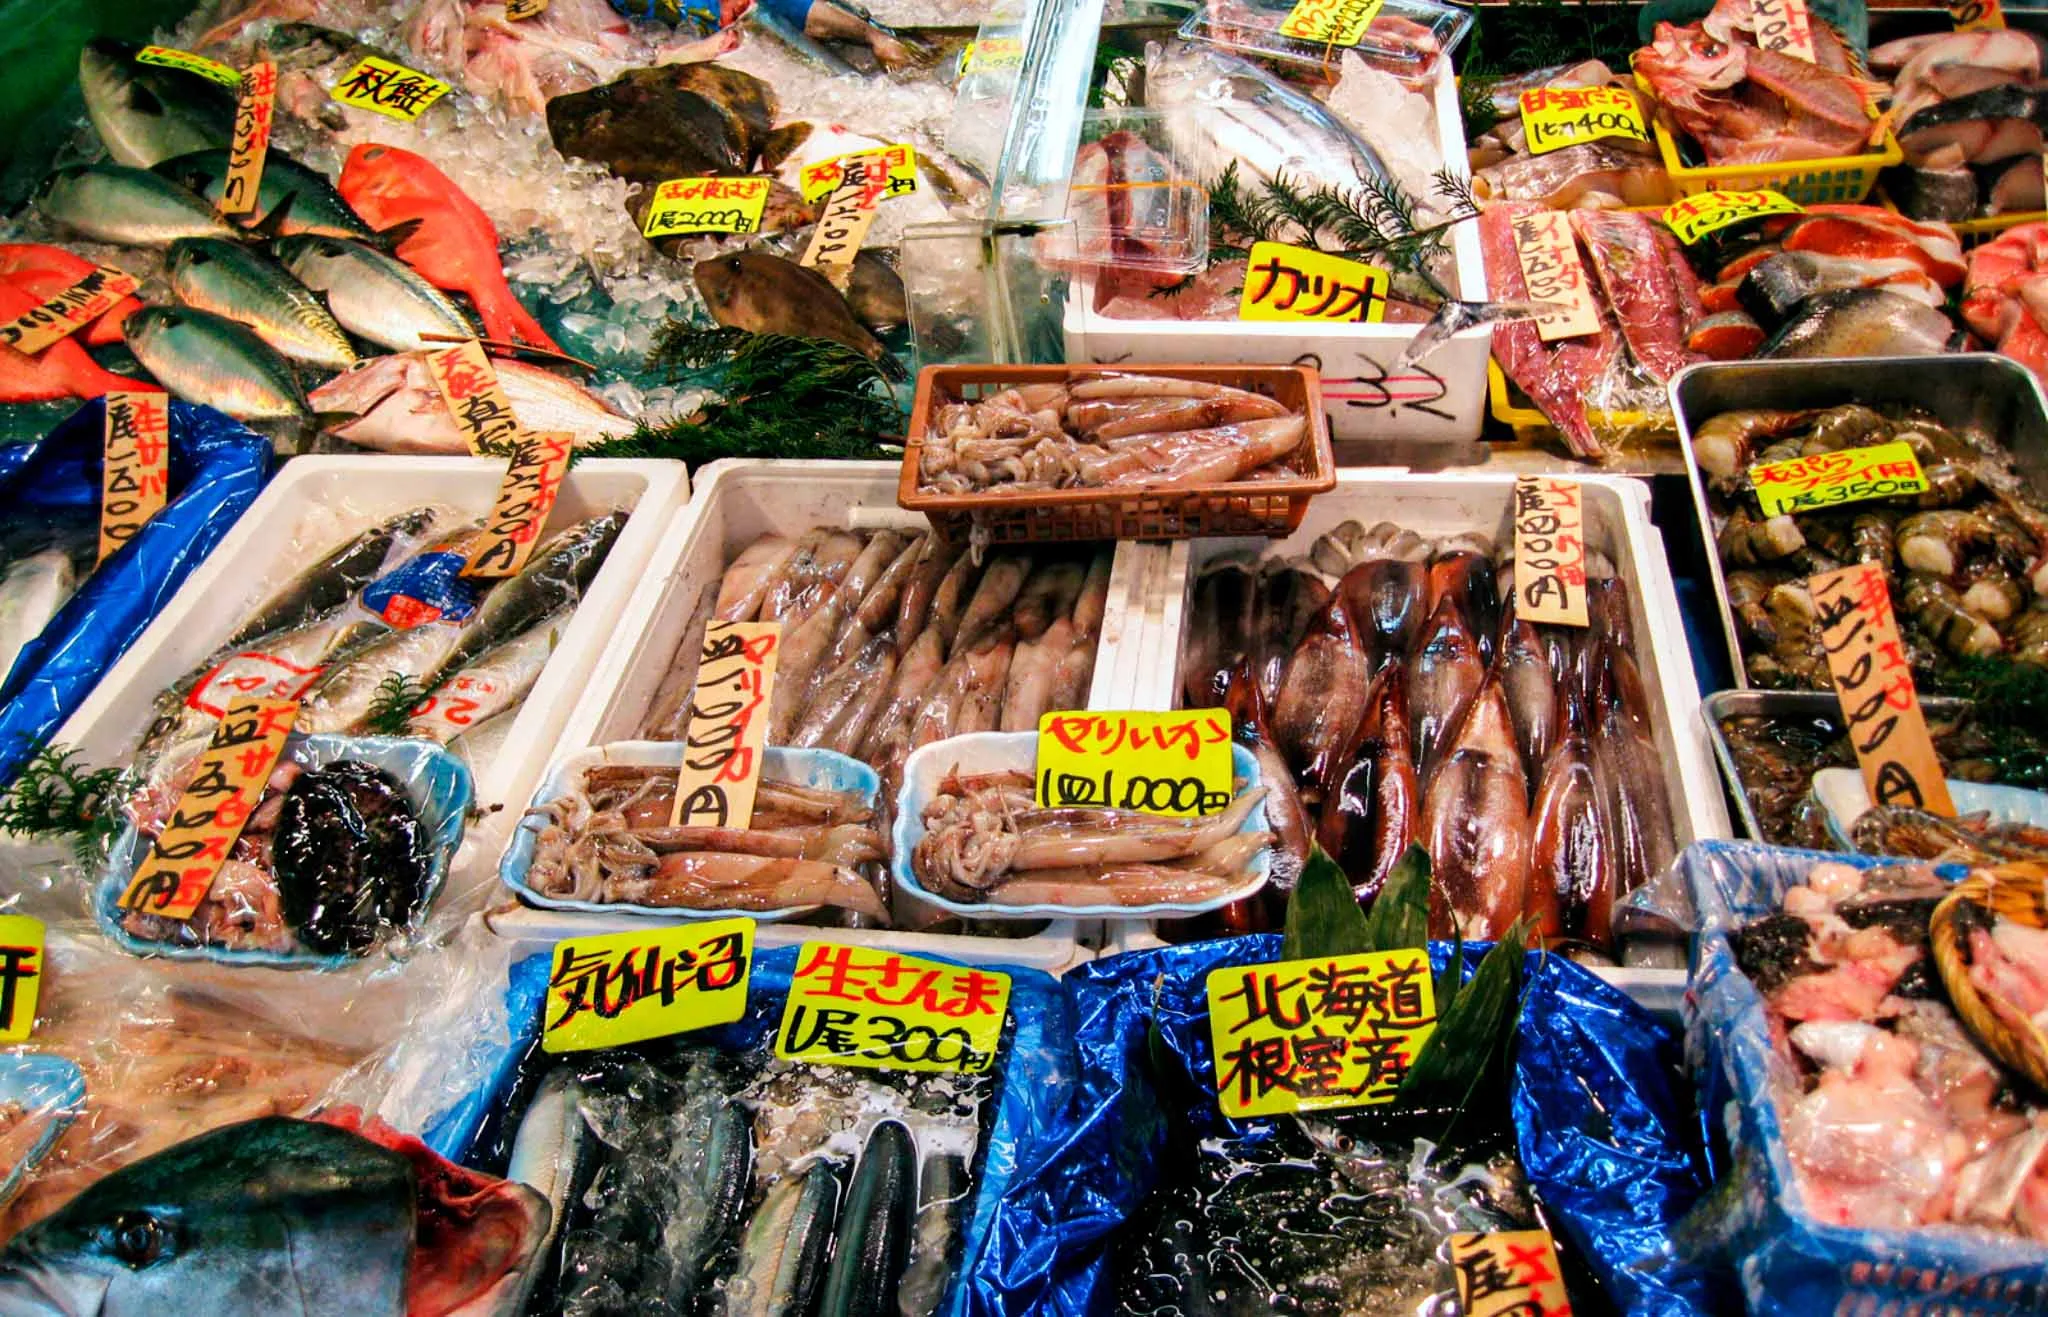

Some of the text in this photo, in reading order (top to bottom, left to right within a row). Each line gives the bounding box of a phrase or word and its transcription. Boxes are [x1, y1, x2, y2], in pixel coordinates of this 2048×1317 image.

[340, 64, 441, 116] 秋鮭
[1251, 257, 1387, 322] カツオ
[1777, 480, 1921, 515] 1尾350円
[1791, 461, 1916, 490] フライ用
[1045, 716, 1229, 760] やりいか
[547, 932, 747, 1032] 気仙沼
[794, 946, 1000, 1017] 生さんま
[1219, 958, 1437, 1034] 北海道
[785, 1005, 991, 1070] 1尾300円
[1217, 1025, 1410, 1107] 根室産
